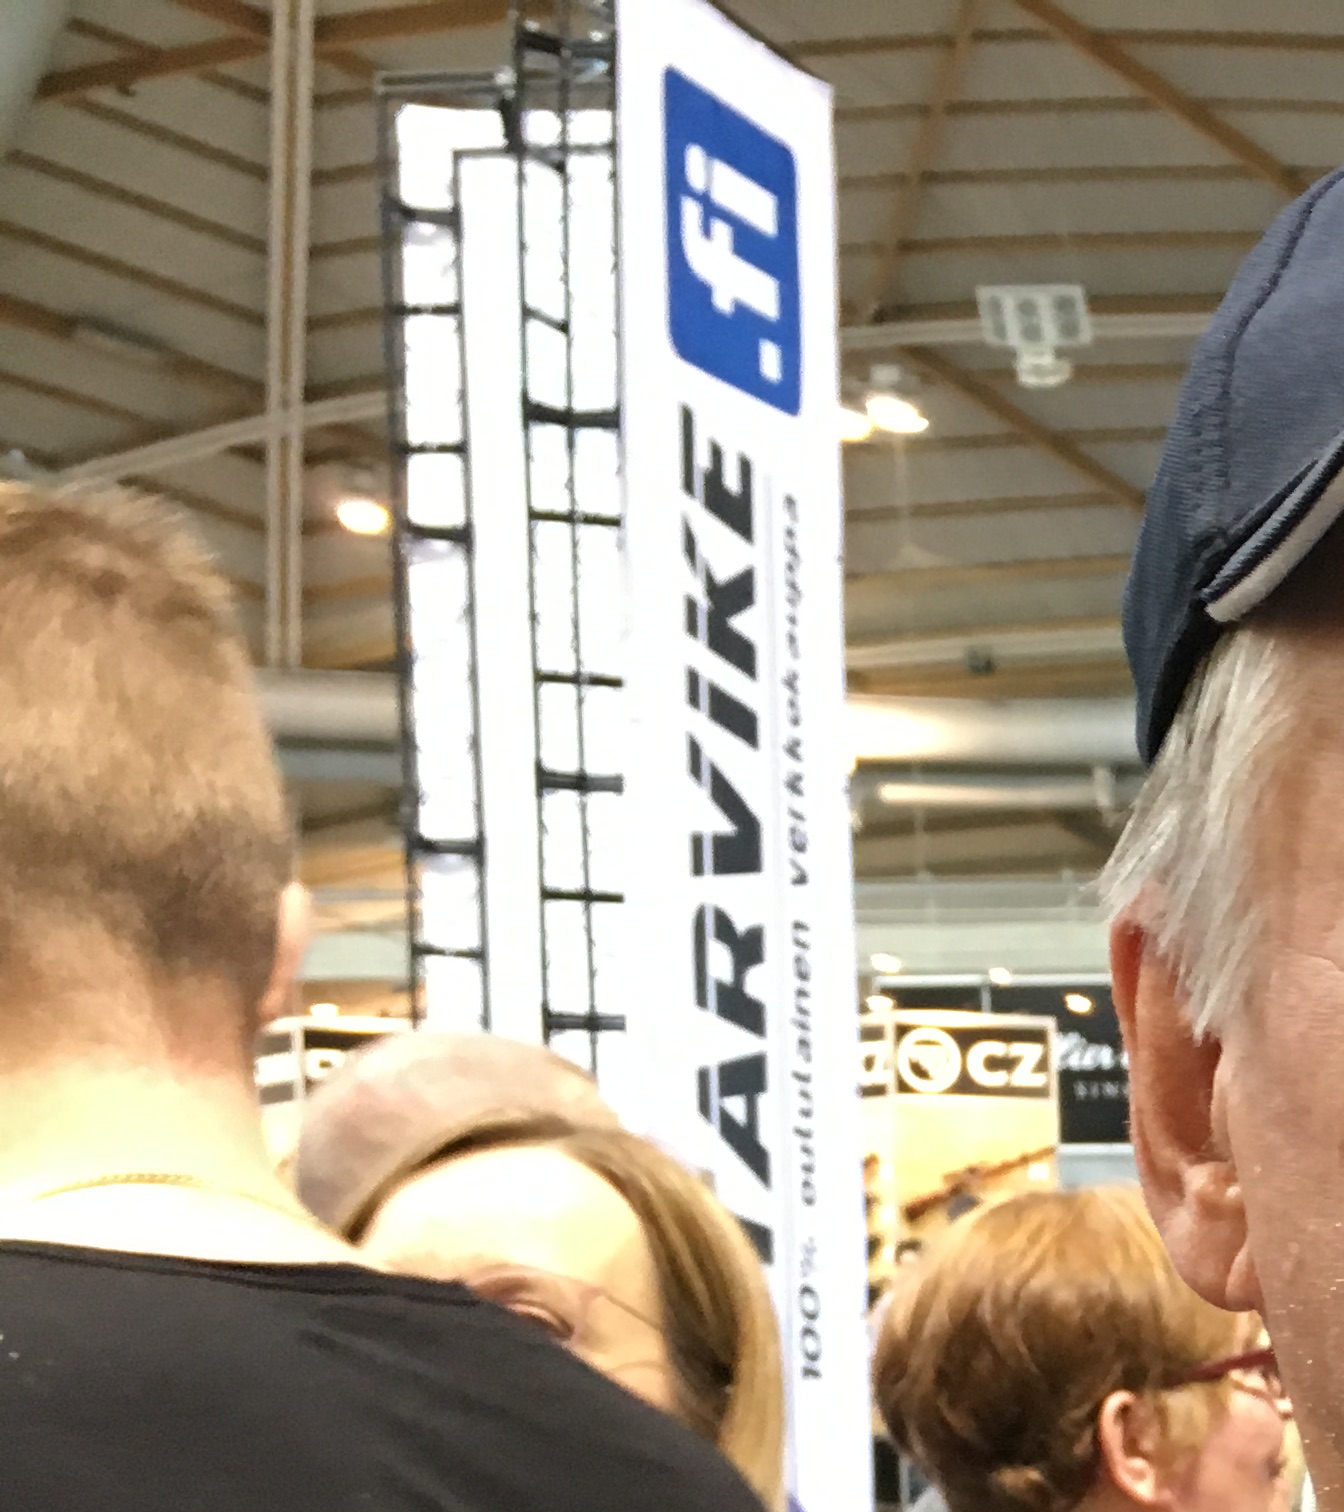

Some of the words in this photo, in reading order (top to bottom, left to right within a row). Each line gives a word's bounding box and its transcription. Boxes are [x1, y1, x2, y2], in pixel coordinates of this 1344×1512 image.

[680, 142, 783, 384] .fi
[966, 1039, 1047, 1088] CZ
[800, 1236, 822, 1380] 100%
